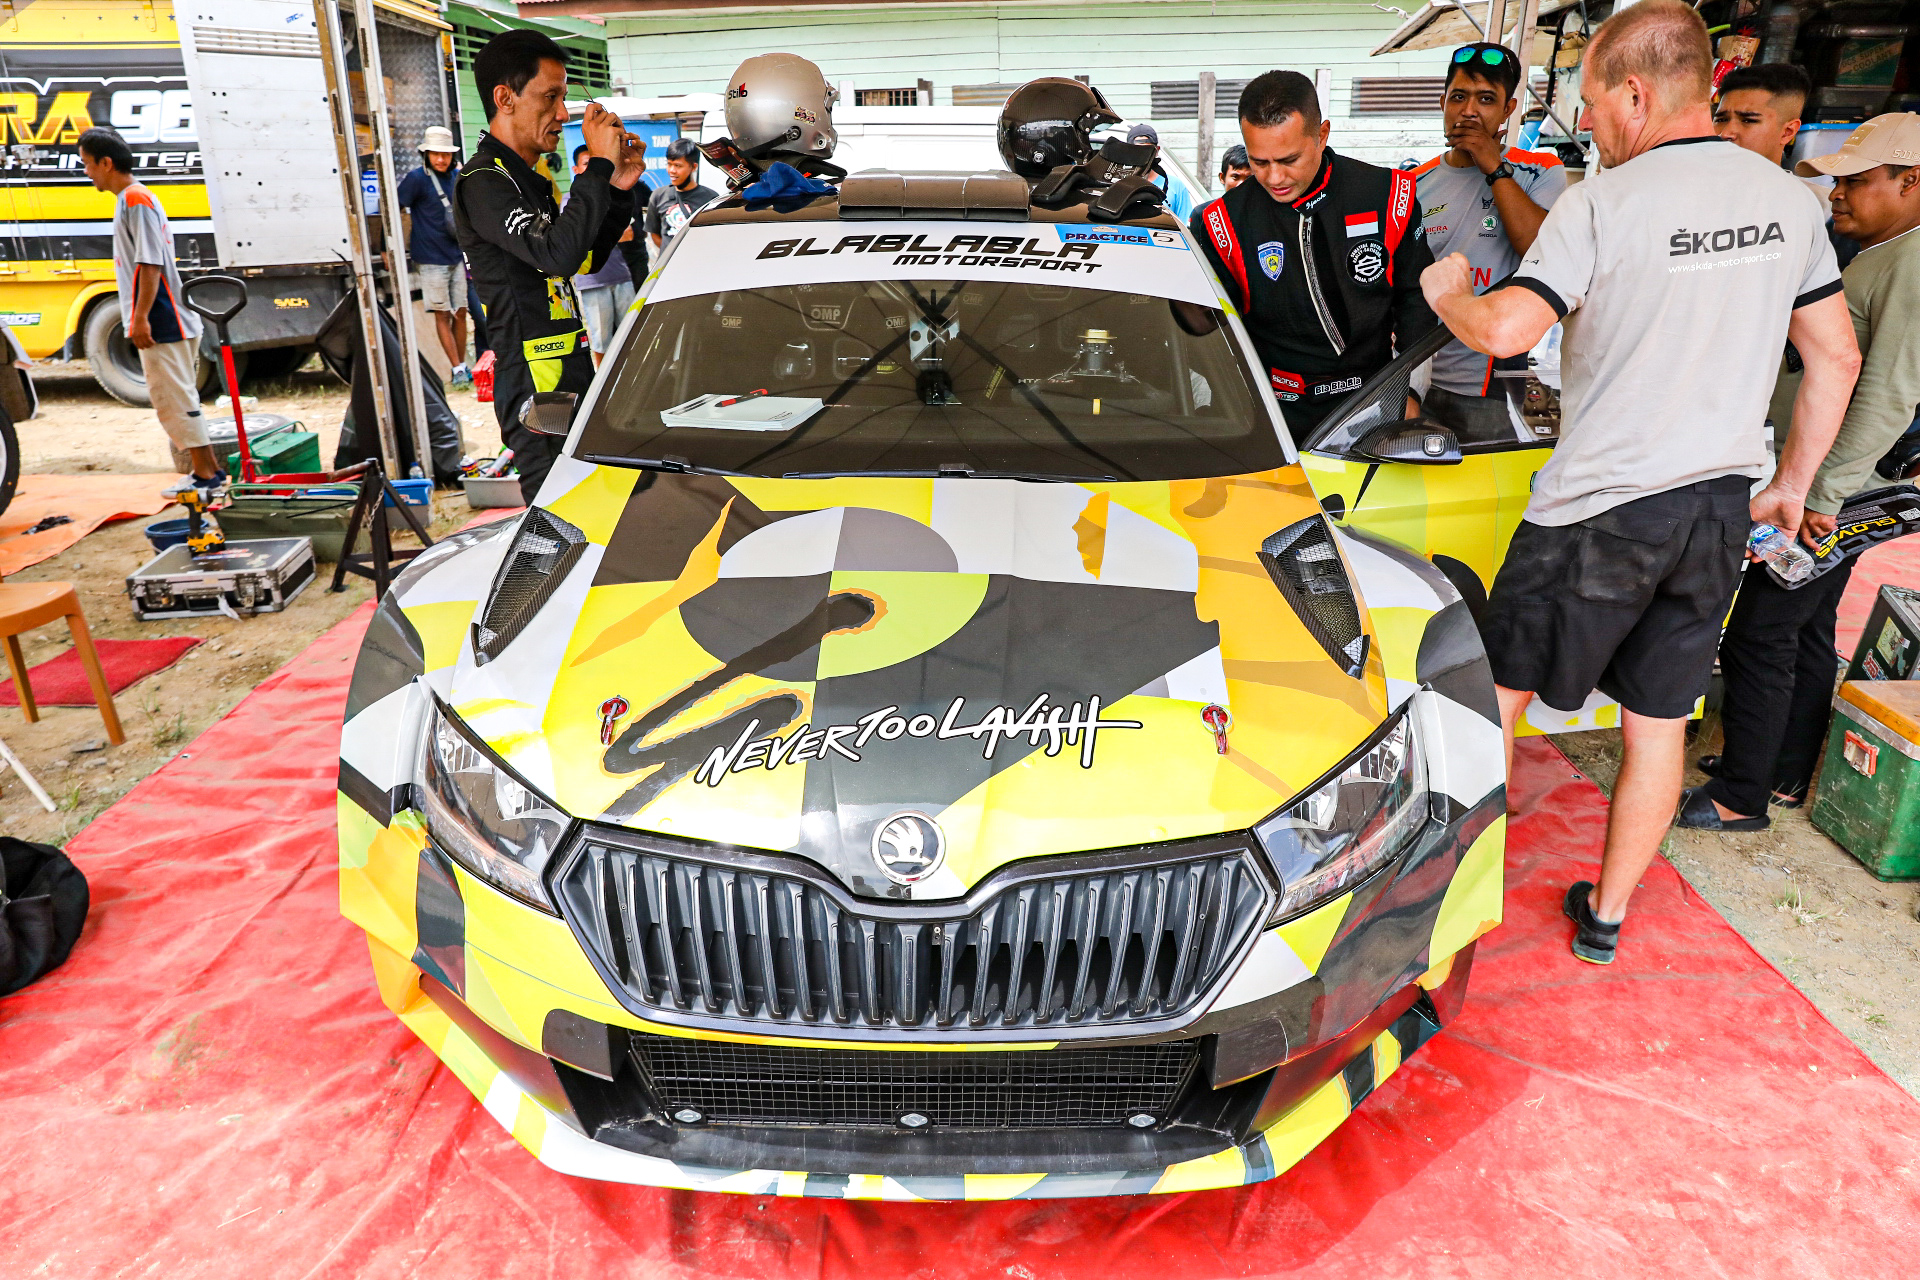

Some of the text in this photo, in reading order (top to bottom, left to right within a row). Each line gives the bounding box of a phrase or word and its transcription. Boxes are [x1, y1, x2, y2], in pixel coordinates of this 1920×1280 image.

[1397, 178, 1411, 218] sparco
[1065, 230, 1175, 244] PRACTICE 5
[1207, 210, 1229, 249] sparco
[1669, 221, 1785, 257] ŠKODA
[755, 234, 1100, 261] BLABLABLA
[892, 254, 1103, 274] MOTORSPORT
[721, 317, 743, 327] OMP
[811, 307, 841, 322] OMP
[885, 316, 906, 327] OMP
[533, 341, 565, 353] sparco
[1272, 374, 1299, 389] sparco
[1815, 517, 1897, 559] GLOVES
[693, 692, 1144, 789] NEVER TOO LAVISH
